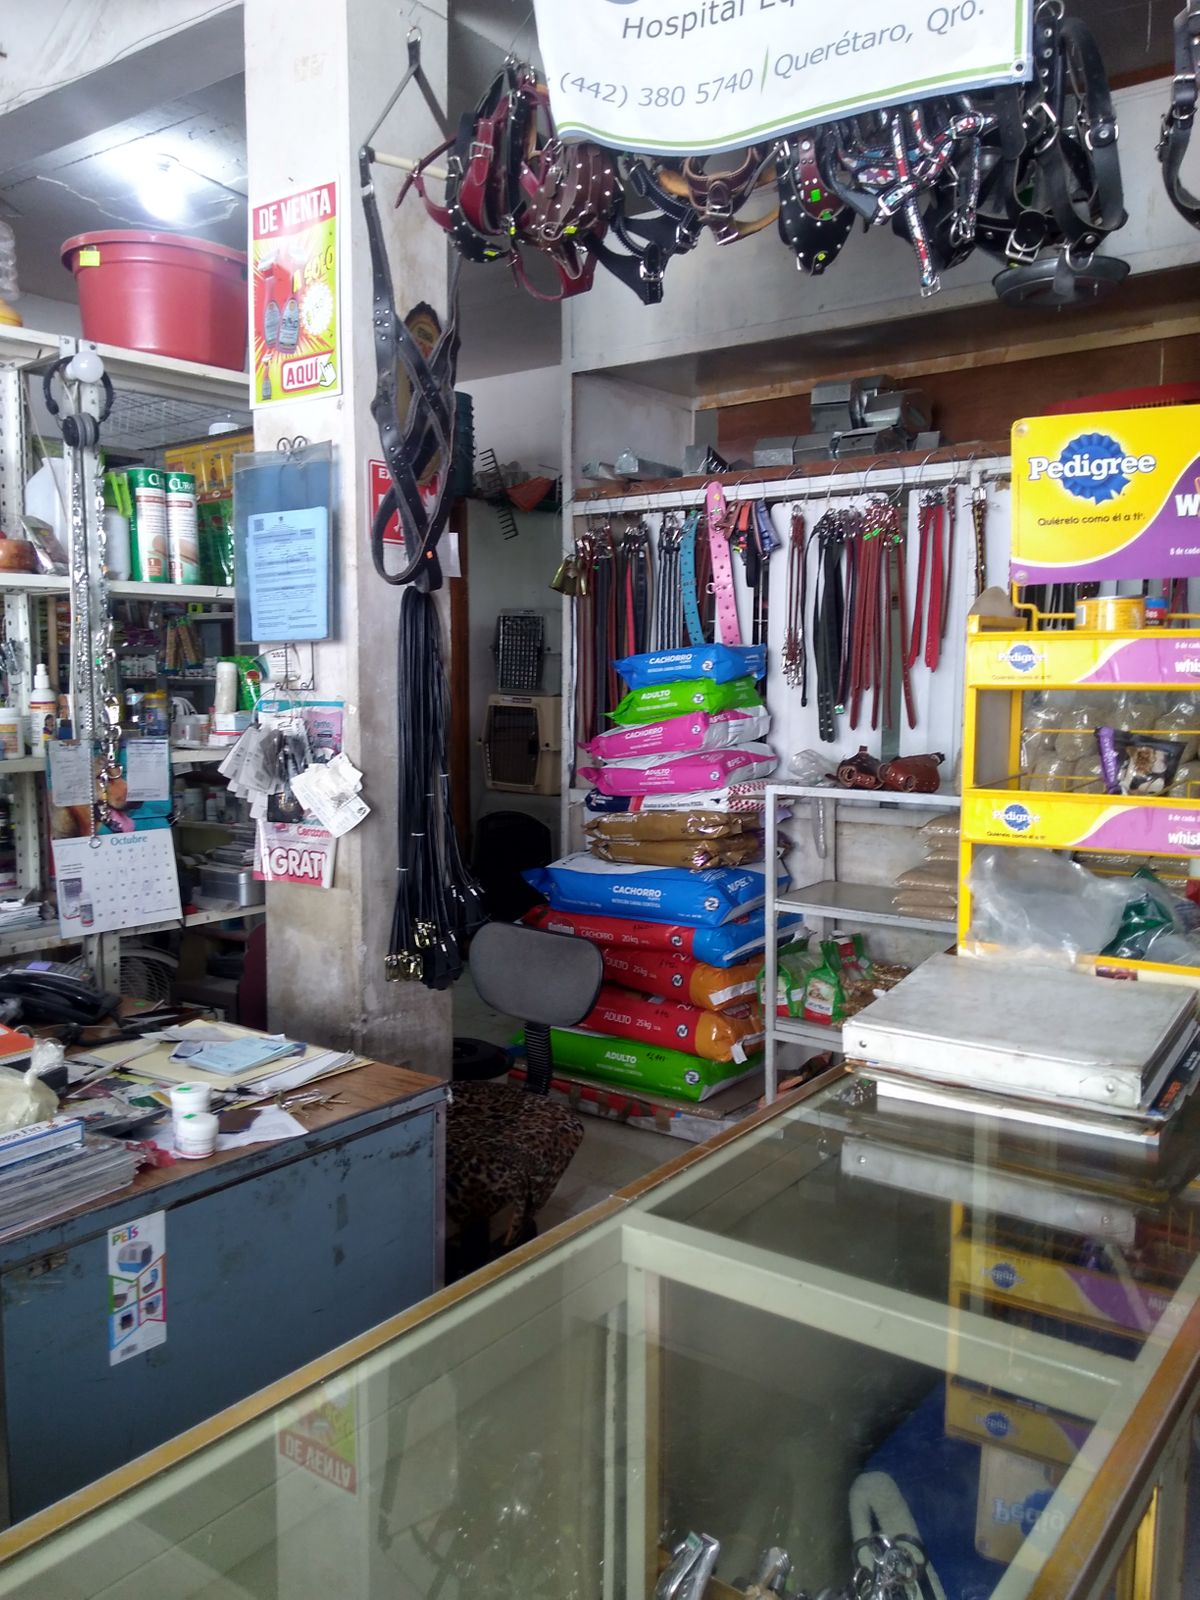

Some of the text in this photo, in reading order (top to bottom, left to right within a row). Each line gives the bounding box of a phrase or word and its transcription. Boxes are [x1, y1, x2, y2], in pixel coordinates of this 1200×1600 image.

[622, 0, 744, 39] Hospital
[559, 0, 985, 108] (442) 380 5740 Querétaro, Qro.
[258, 188, 332, 236] DE VENTA
[286, 357, 319, 386] AQUÍ
[1028, 453, 1157, 481] Pedigree
[1082, 515, 1110, 523] como
[648, 653, 693, 665] CACHORRO
[640, 688, 671, 700] ADULTO
[624, 726, 664, 740] CACHORRO
[110, 834, 148, 846] Octubre
[612, 885, 662, 898] CACHORRO
[605, 956, 629, 971] DULTO
[603, 1011, 632, 1025] ADULTO
[604, 1050, 637, 1064] ADULTO
